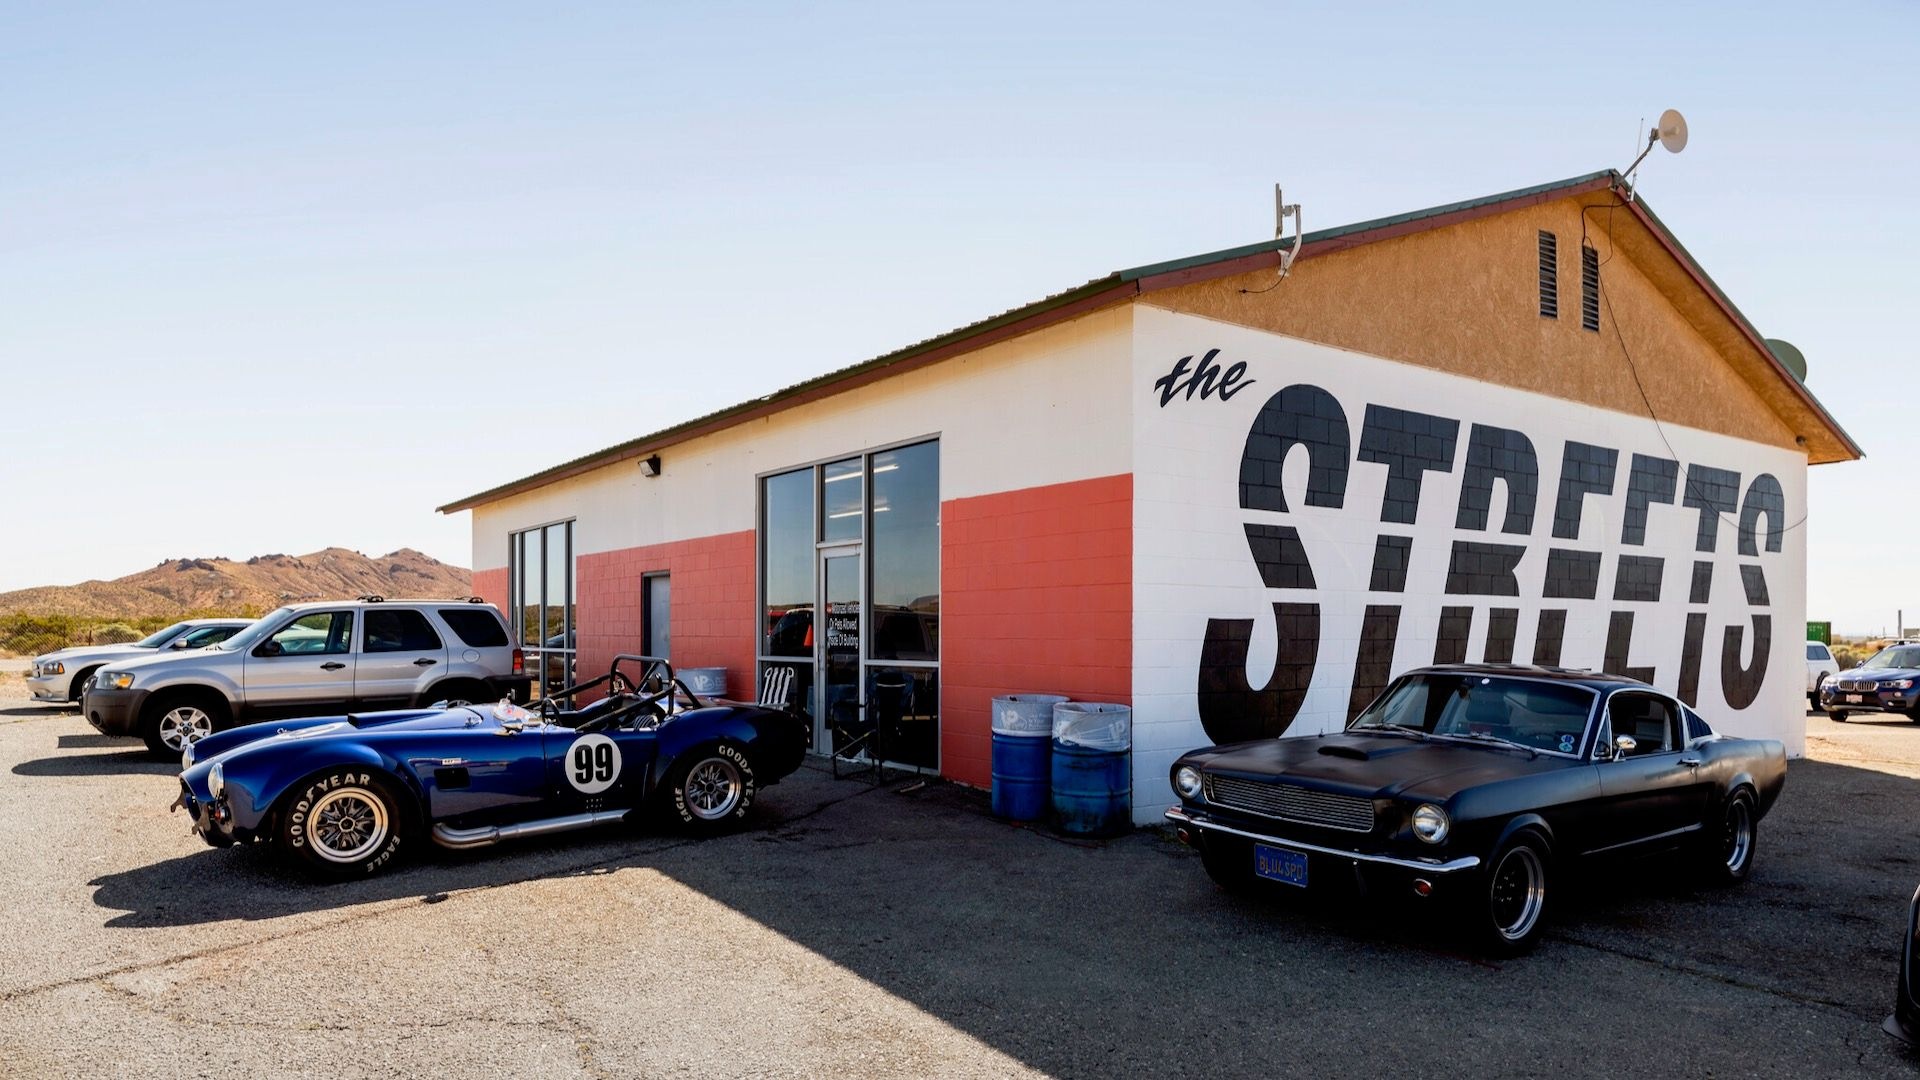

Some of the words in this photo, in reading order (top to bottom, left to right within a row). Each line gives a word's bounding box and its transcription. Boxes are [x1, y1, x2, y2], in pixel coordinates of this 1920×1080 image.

[1154, 348, 1256, 408] the
[1197, 384, 1785, 747] STREETS
[574, 743, 614, 784] 99
[718, 745, 754, 818] GOODYEAR
[290, 773, 370, 848] GOODYEAR
[674, 787, 693, 822] EAGLE
[367, 835, 401, 872] EAGLE
